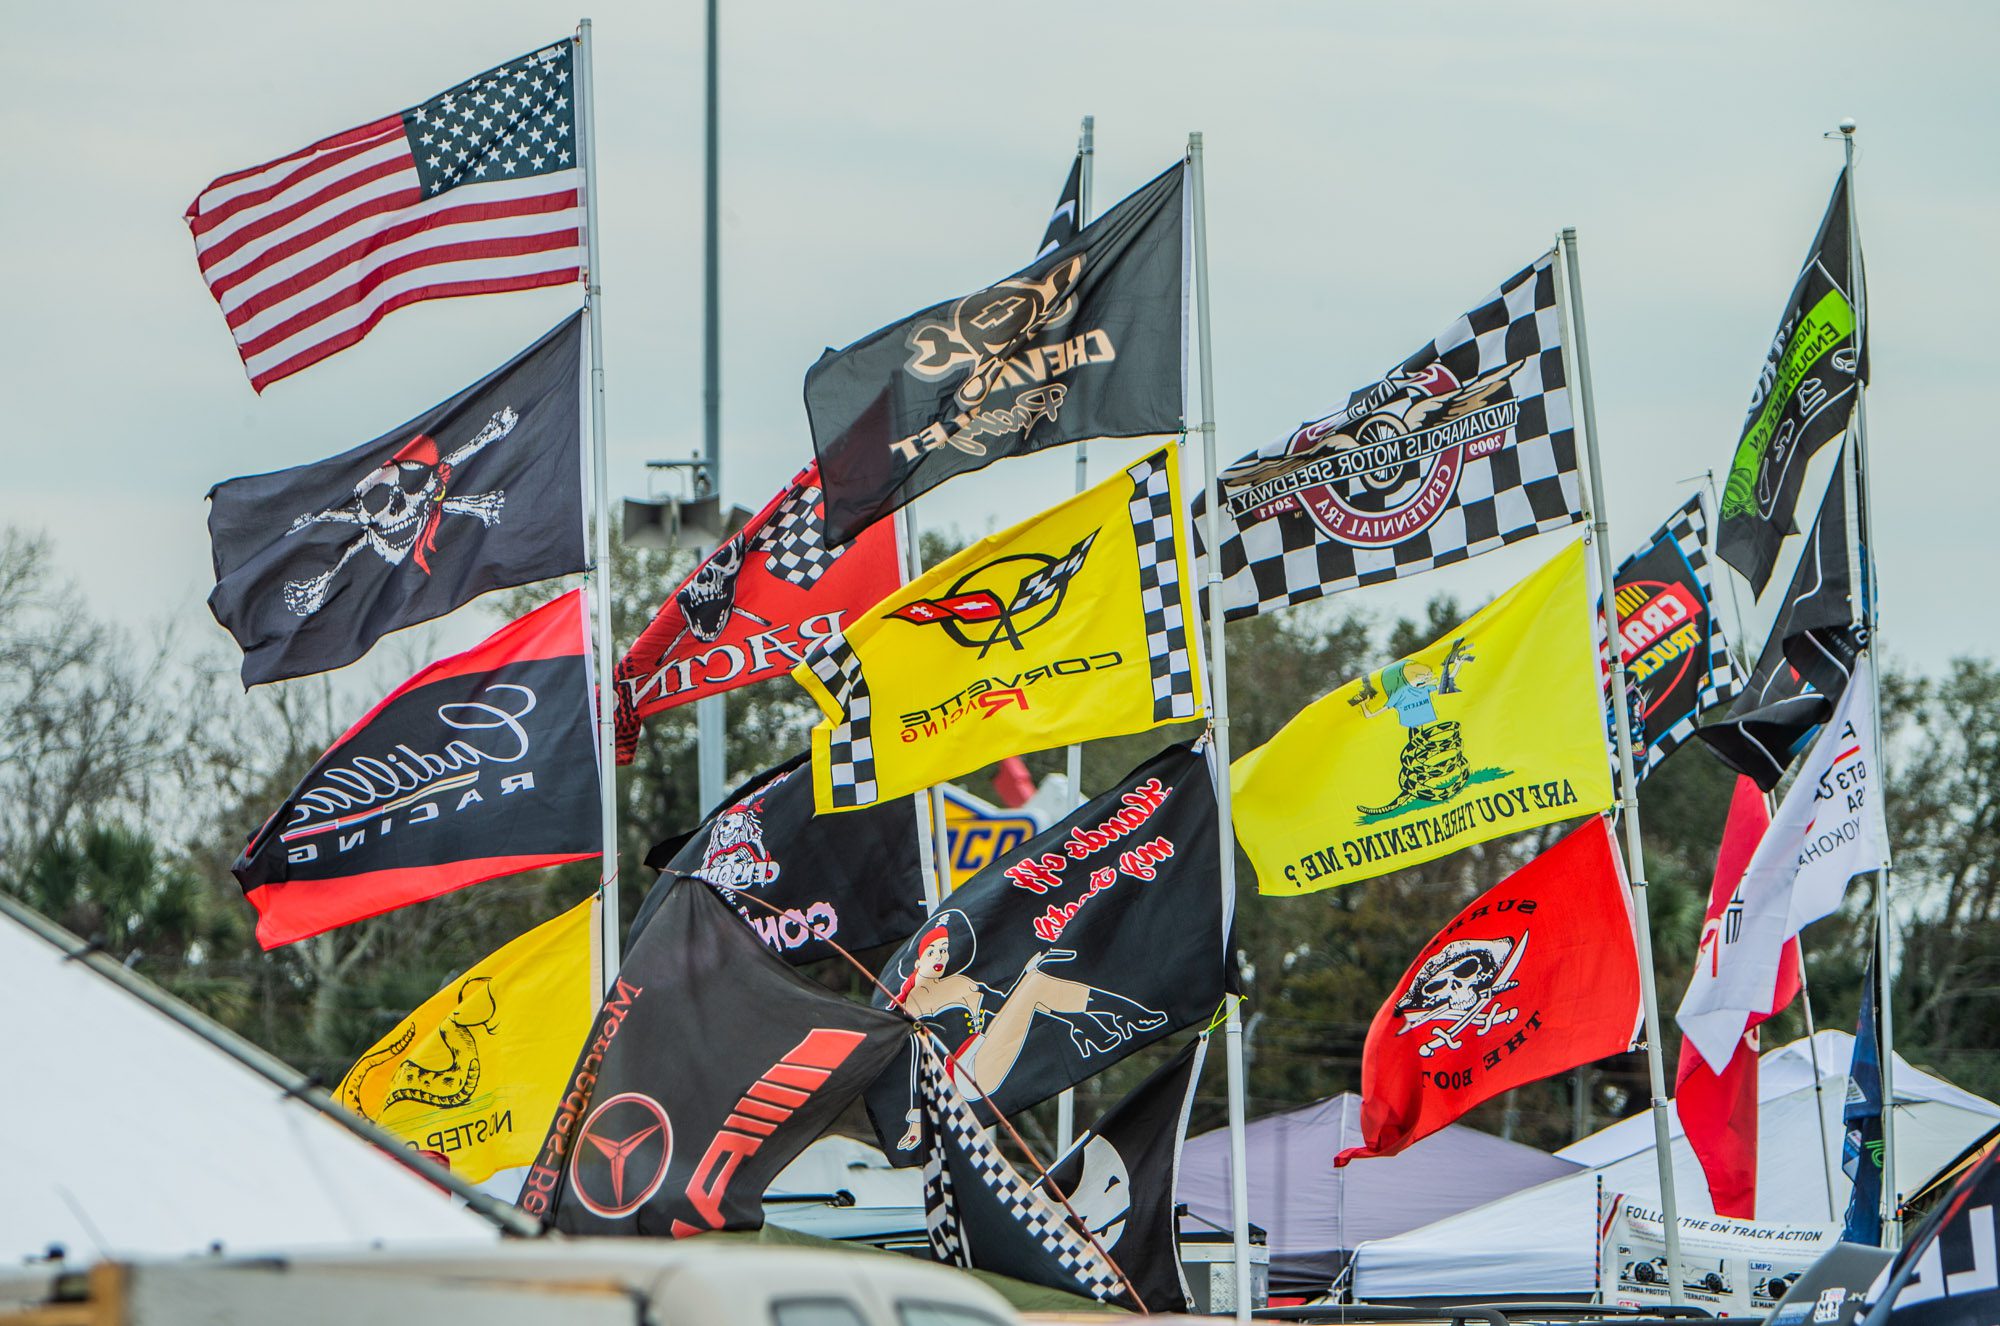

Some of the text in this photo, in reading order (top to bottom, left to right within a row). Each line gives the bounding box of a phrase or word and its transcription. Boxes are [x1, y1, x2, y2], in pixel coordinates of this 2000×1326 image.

[1626, 1205, 1682, 1227] FOLLO
[1682, 1217, 1708, 1231] THE
[1710, 1221, 1729, 1234] ON
[1732, 1225, 1775, 1241] TRACK
[1775, 1230, 1824, 1242] ACTION
[1750, 1262, 1772, 1272] LMP2
[1618, 1284, 1644, 1294] DAYTONA
